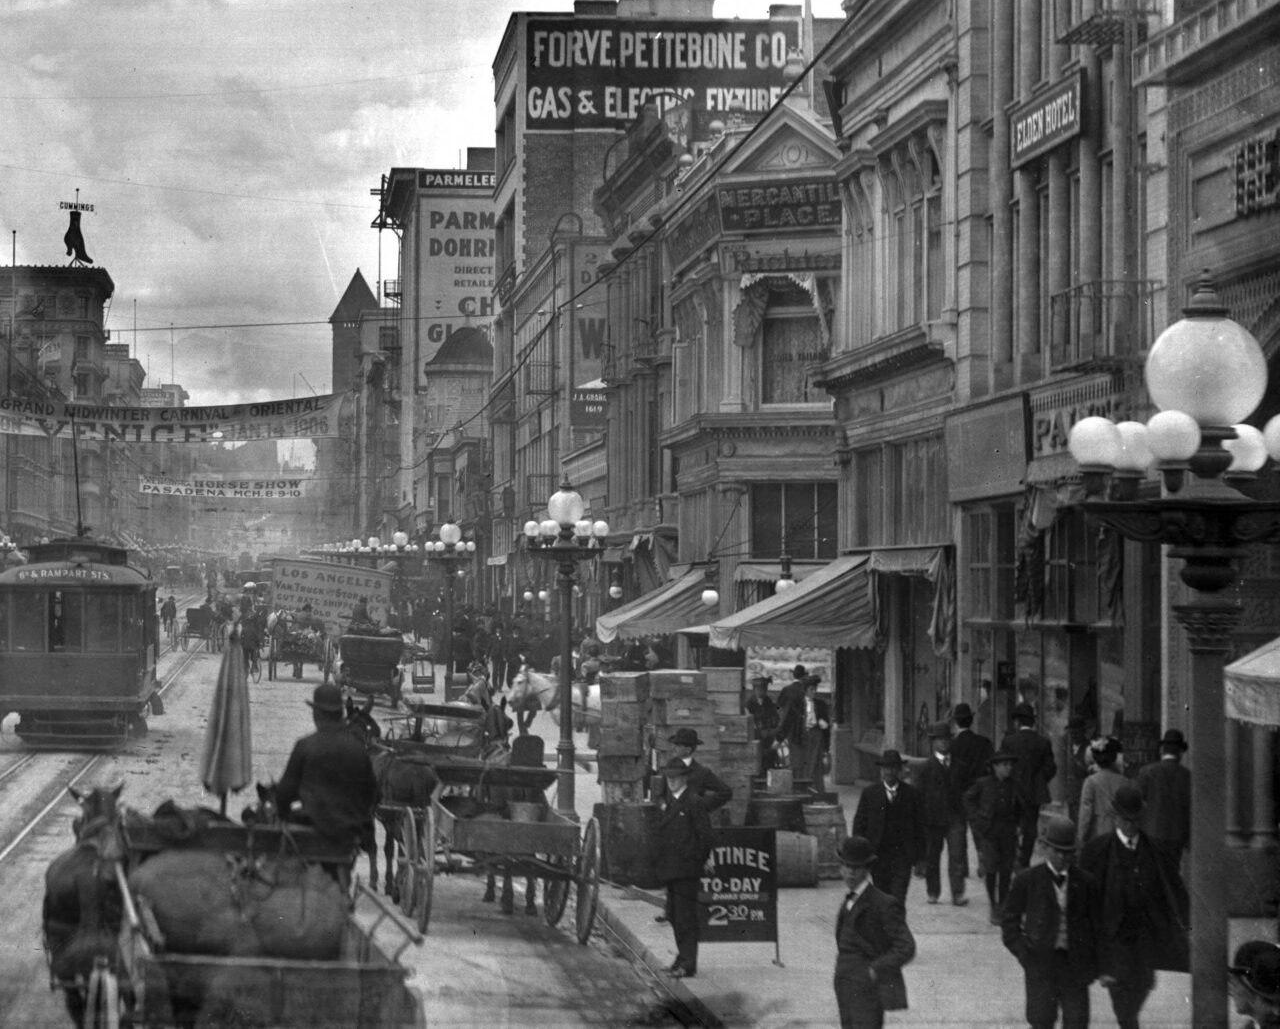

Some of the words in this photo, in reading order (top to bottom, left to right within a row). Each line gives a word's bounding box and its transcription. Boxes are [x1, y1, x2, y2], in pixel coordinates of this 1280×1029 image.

[620, 31, 747, 69] PETTEBONE
[528, 86, 572, 119] GAS
[578, 91, 597, 114] &
[1017, 108, 1044, 152] ELDEN
[1045, 91, 1075, 136] HOTEL
[720, 183, 843, 208] MERCANTIL
[59, 201, 95, 212] CUMMINGS
[1, 398, 55, 416] GRAND
[64, 405, 150, 422] MIDWINTER
[160, 408, 229, 422] CARNIVAL
[249, 398, 326, 418] ORIENTAL
[142, 484, 226, 497] PASADENA
[194, 480, 250, 490] HORSE
[254, 480, 301, 489] SHOW
[40, 570, 87, 579] RAMPART
[282, 568, 309, 579] LOS
[315, 571, 382, 589] ANGELES
[700, 877, 762, 892] TO-DAY
